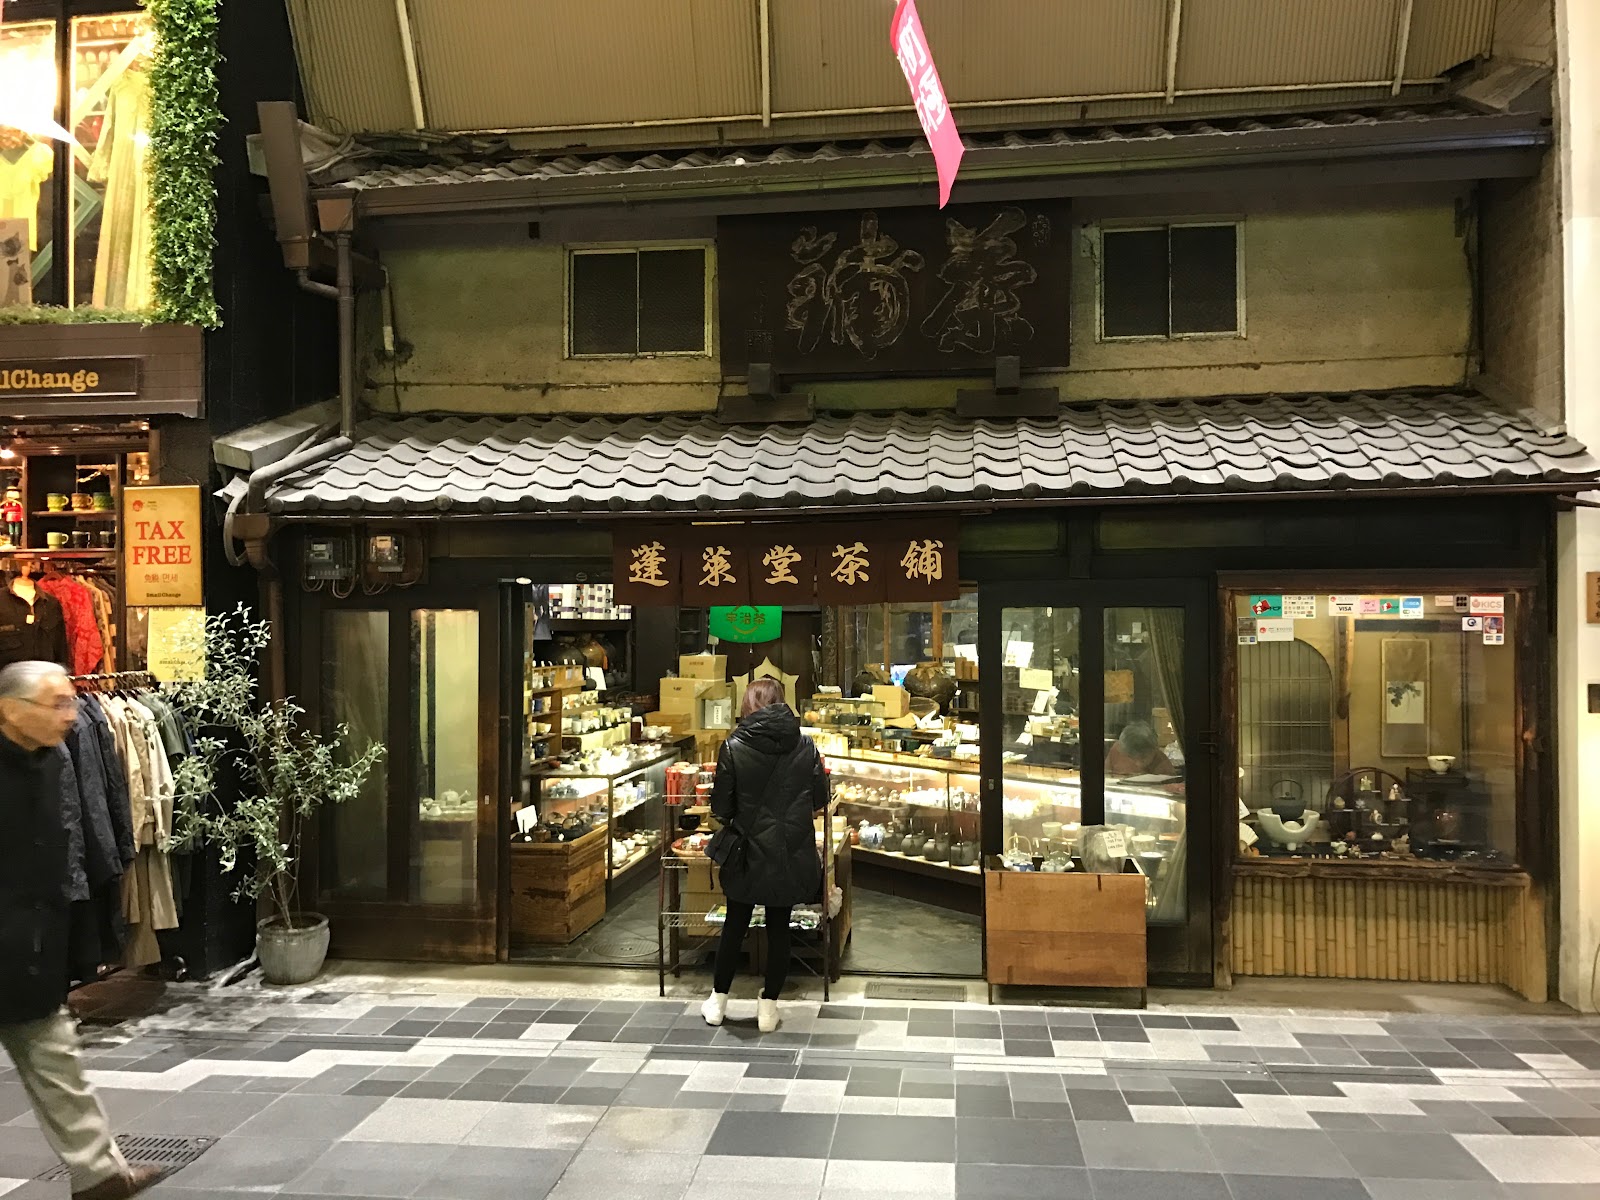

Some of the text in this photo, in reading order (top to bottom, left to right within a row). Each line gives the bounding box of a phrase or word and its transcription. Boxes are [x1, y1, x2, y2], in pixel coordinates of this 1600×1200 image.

[135, 520, 185, 540] TAX
[132, 545, 192, 565] FREE
[1481, 600, 1503, 609] KICS
